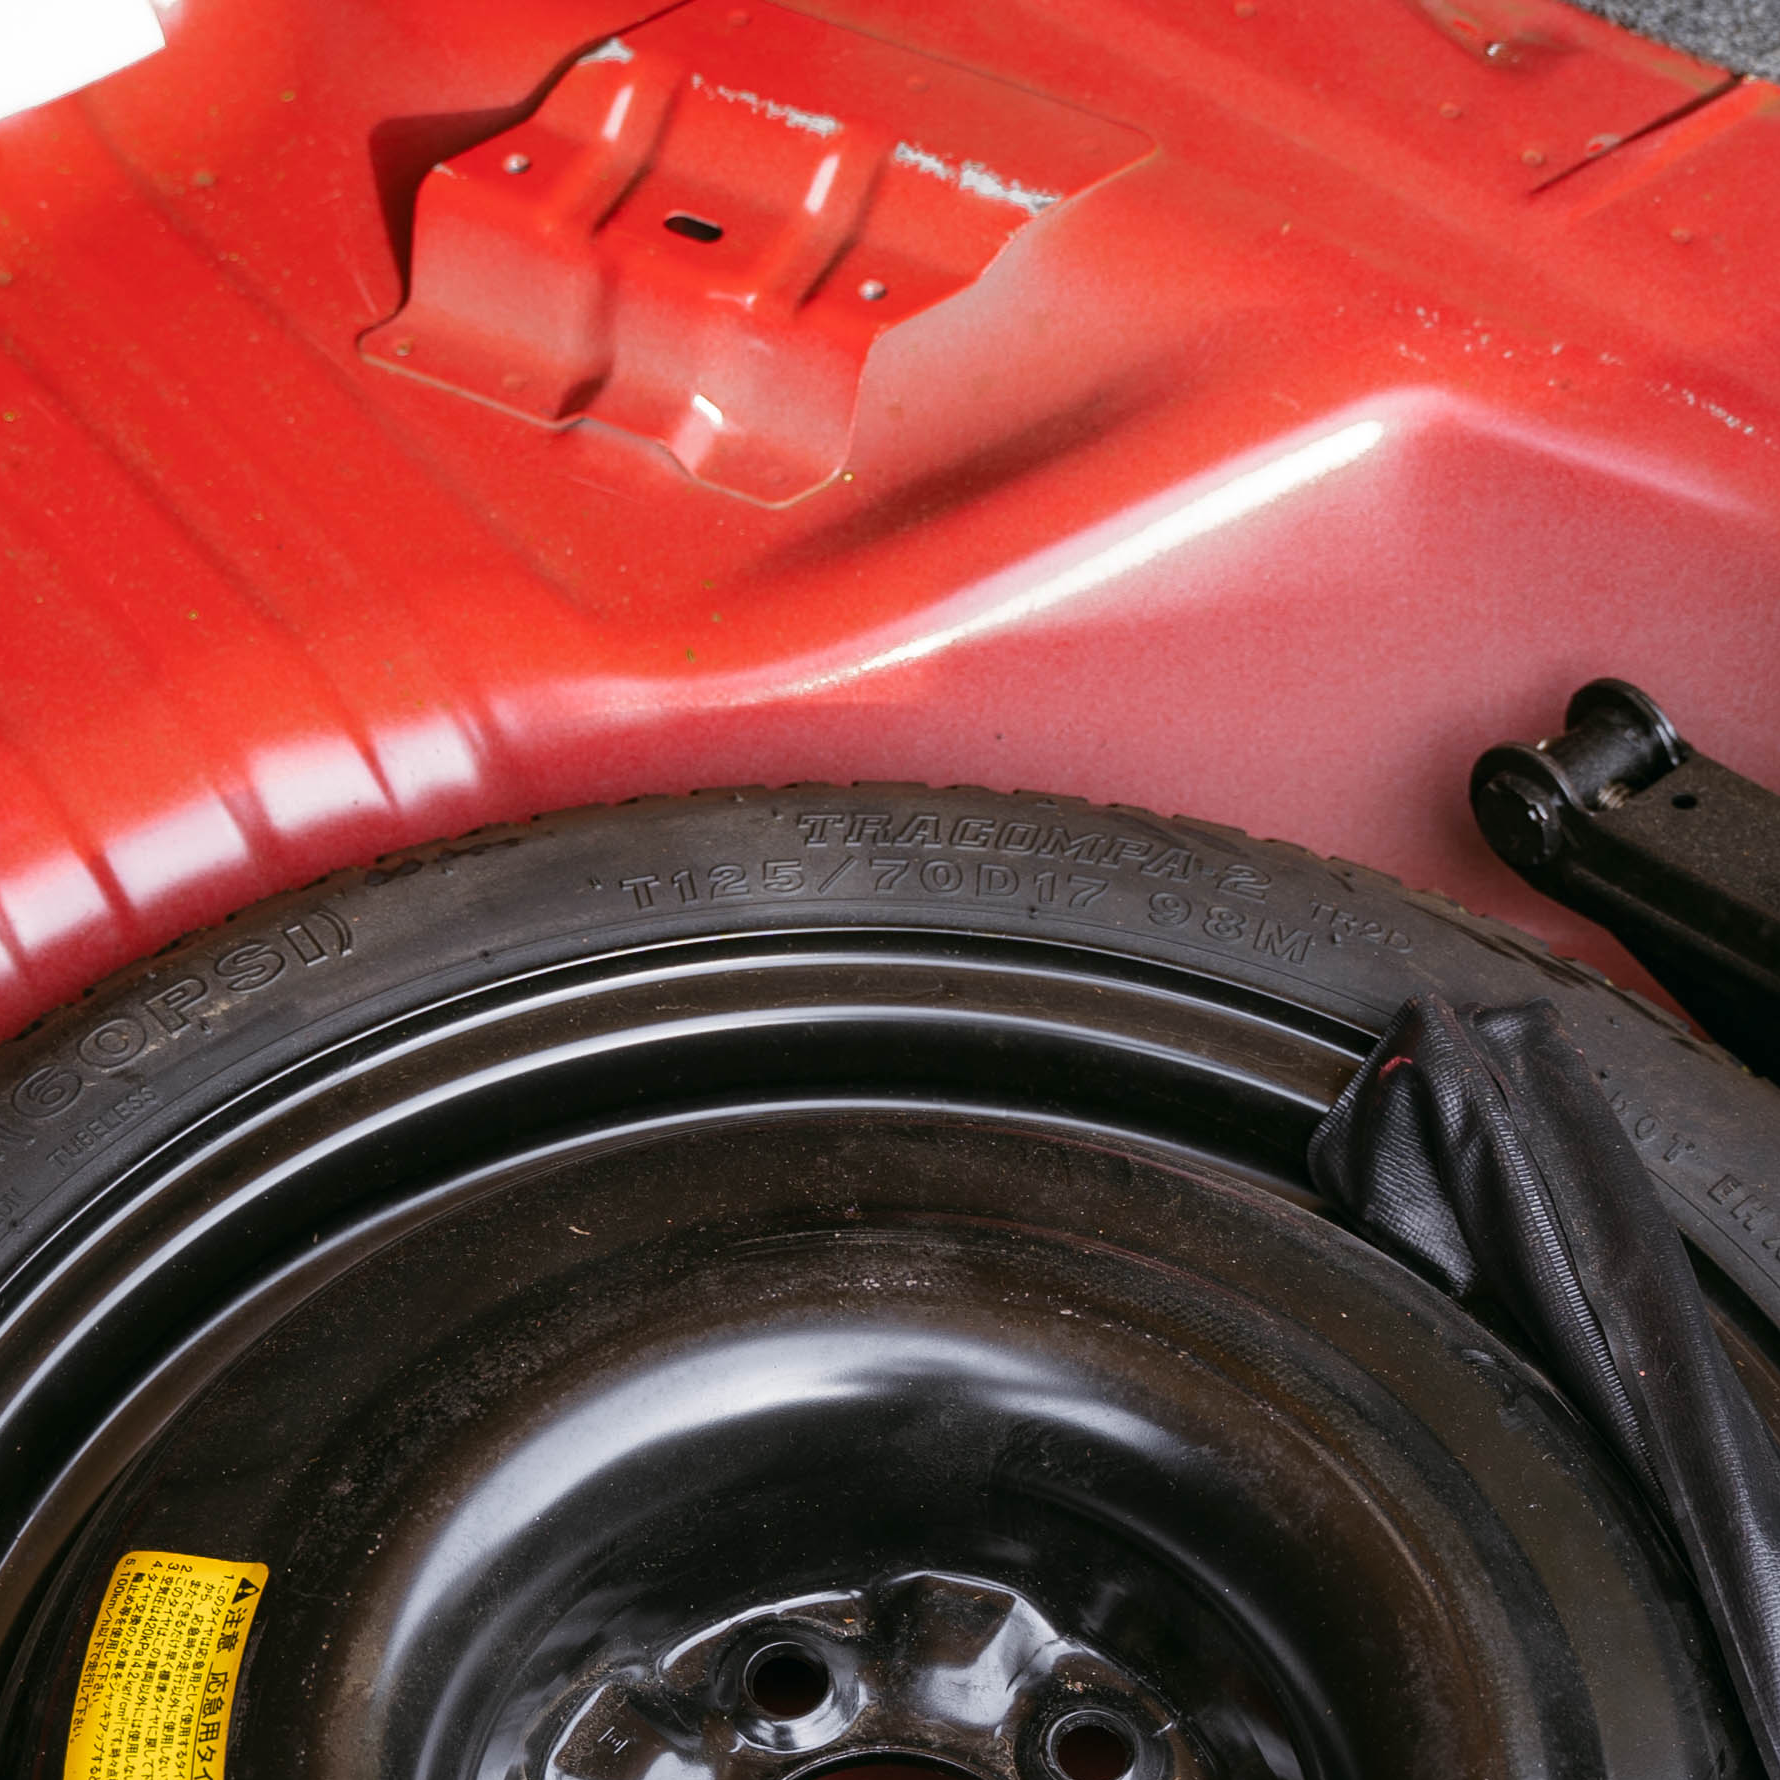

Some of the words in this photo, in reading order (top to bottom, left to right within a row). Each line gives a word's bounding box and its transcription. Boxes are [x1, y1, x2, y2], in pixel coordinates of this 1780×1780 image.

[798, 812, 1273, 902] TRACOMPA-2
[621, 858, 1109, 912] T125/70D17
[1150, 891, 1316, 965] 98M
[47, 1086, 160, 1170] TUBELESS
[216, 1608, 245, 1653] 注意
